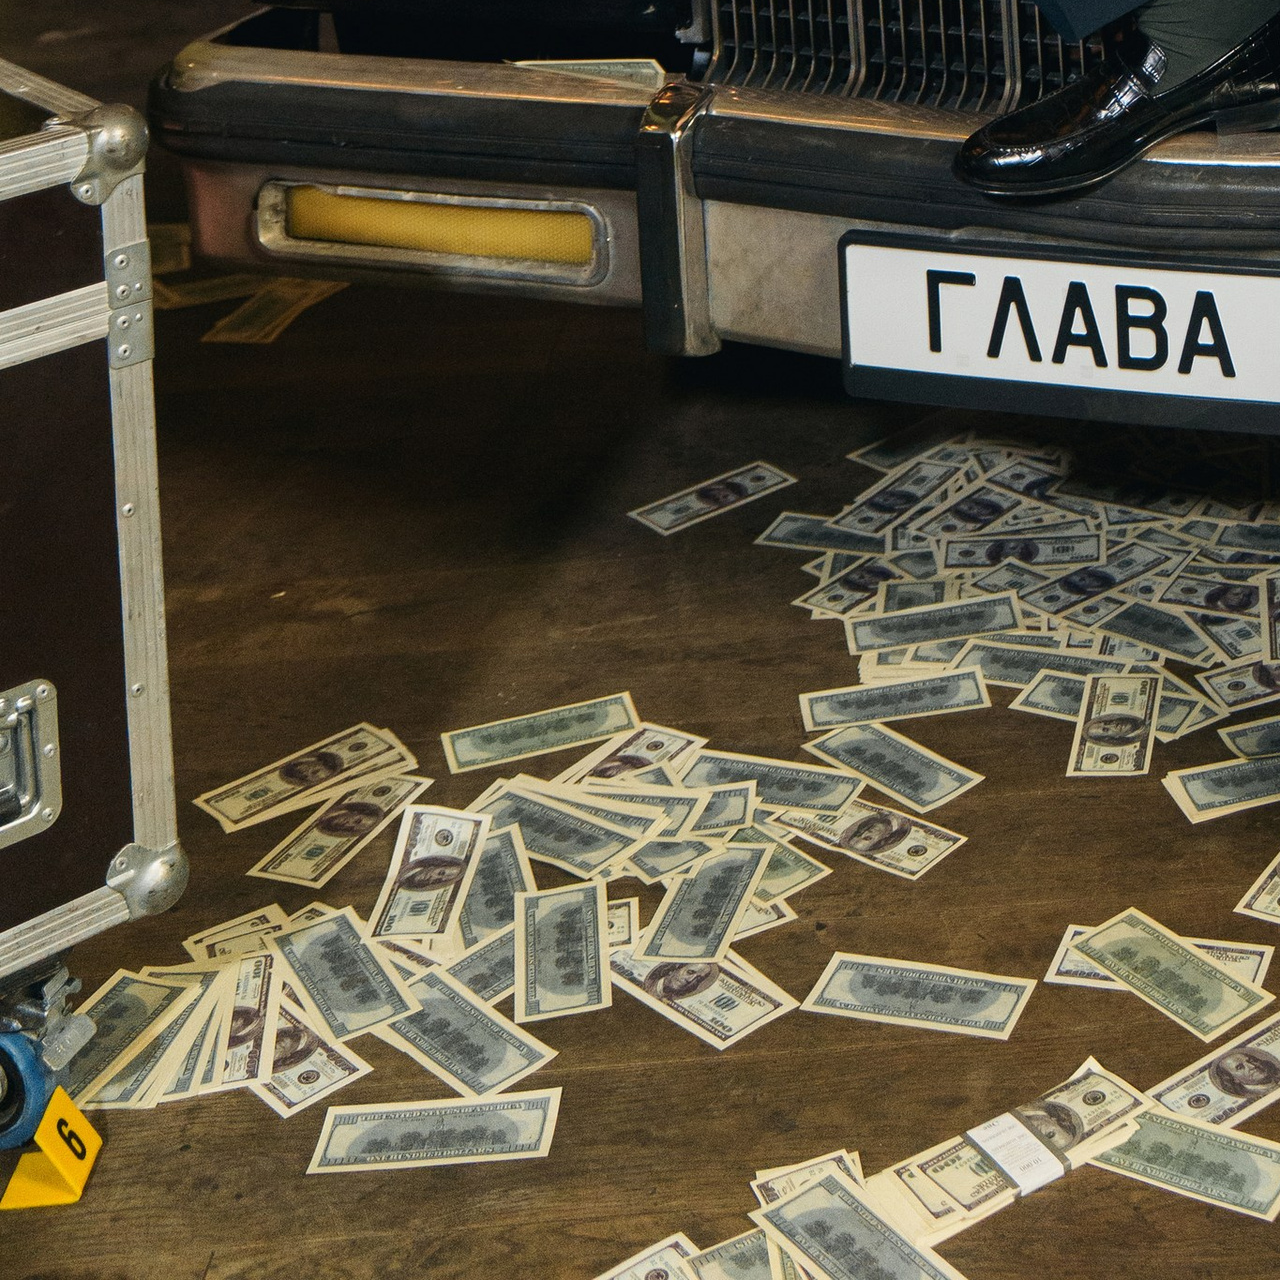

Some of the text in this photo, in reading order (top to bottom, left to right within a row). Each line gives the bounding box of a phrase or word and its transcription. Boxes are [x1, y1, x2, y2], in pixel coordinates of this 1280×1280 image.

[926, 269, 1236, 379] ГЛАВА
[383, 914, 396, 931] 100
[875, 966, 985, 987] ONE HUNDRED DOLLARS
[1103, 958, 1184, 1014] ONE HUNDRED DOLLARS
[707, 1017, 734, 1033] 100
[359, 1113, 383, 1121] THE
[382, 1110, 420, 1120] UNITED
[420, 1106, 462, 1116] STATES
[474, 1101, 523, 1112] AMERICA
[365, 1146, 495, 1162] ONE HUNDRED DOLLARS
[929, 1153, 963, 1174] 100
[1108, 1155, 1228, 1198] ONE HUNDRED DOLLARS
